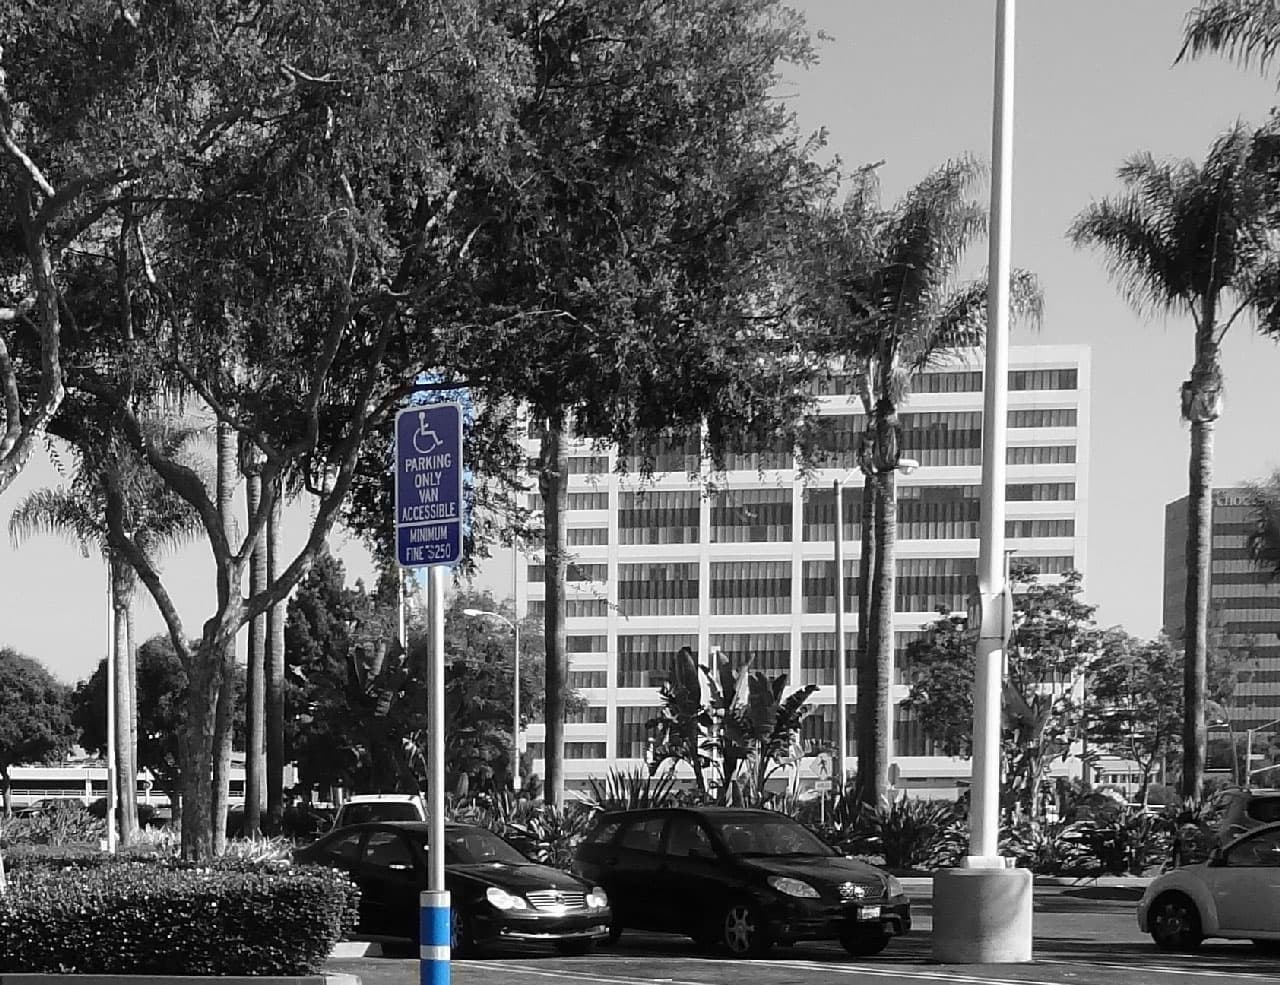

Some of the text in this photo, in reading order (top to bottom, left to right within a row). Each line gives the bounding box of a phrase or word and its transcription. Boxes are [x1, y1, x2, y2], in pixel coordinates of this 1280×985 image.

[405, 453, 451, 472] PARKING
[415, 471, 442, 488] ONLY
[419, 487, 438, 503] VAN
[402, 502, 456, 521] ACCESSIBLE
[410, 525, 448, 543] MINIMUM
[406, 546, 424, 561] FINE
